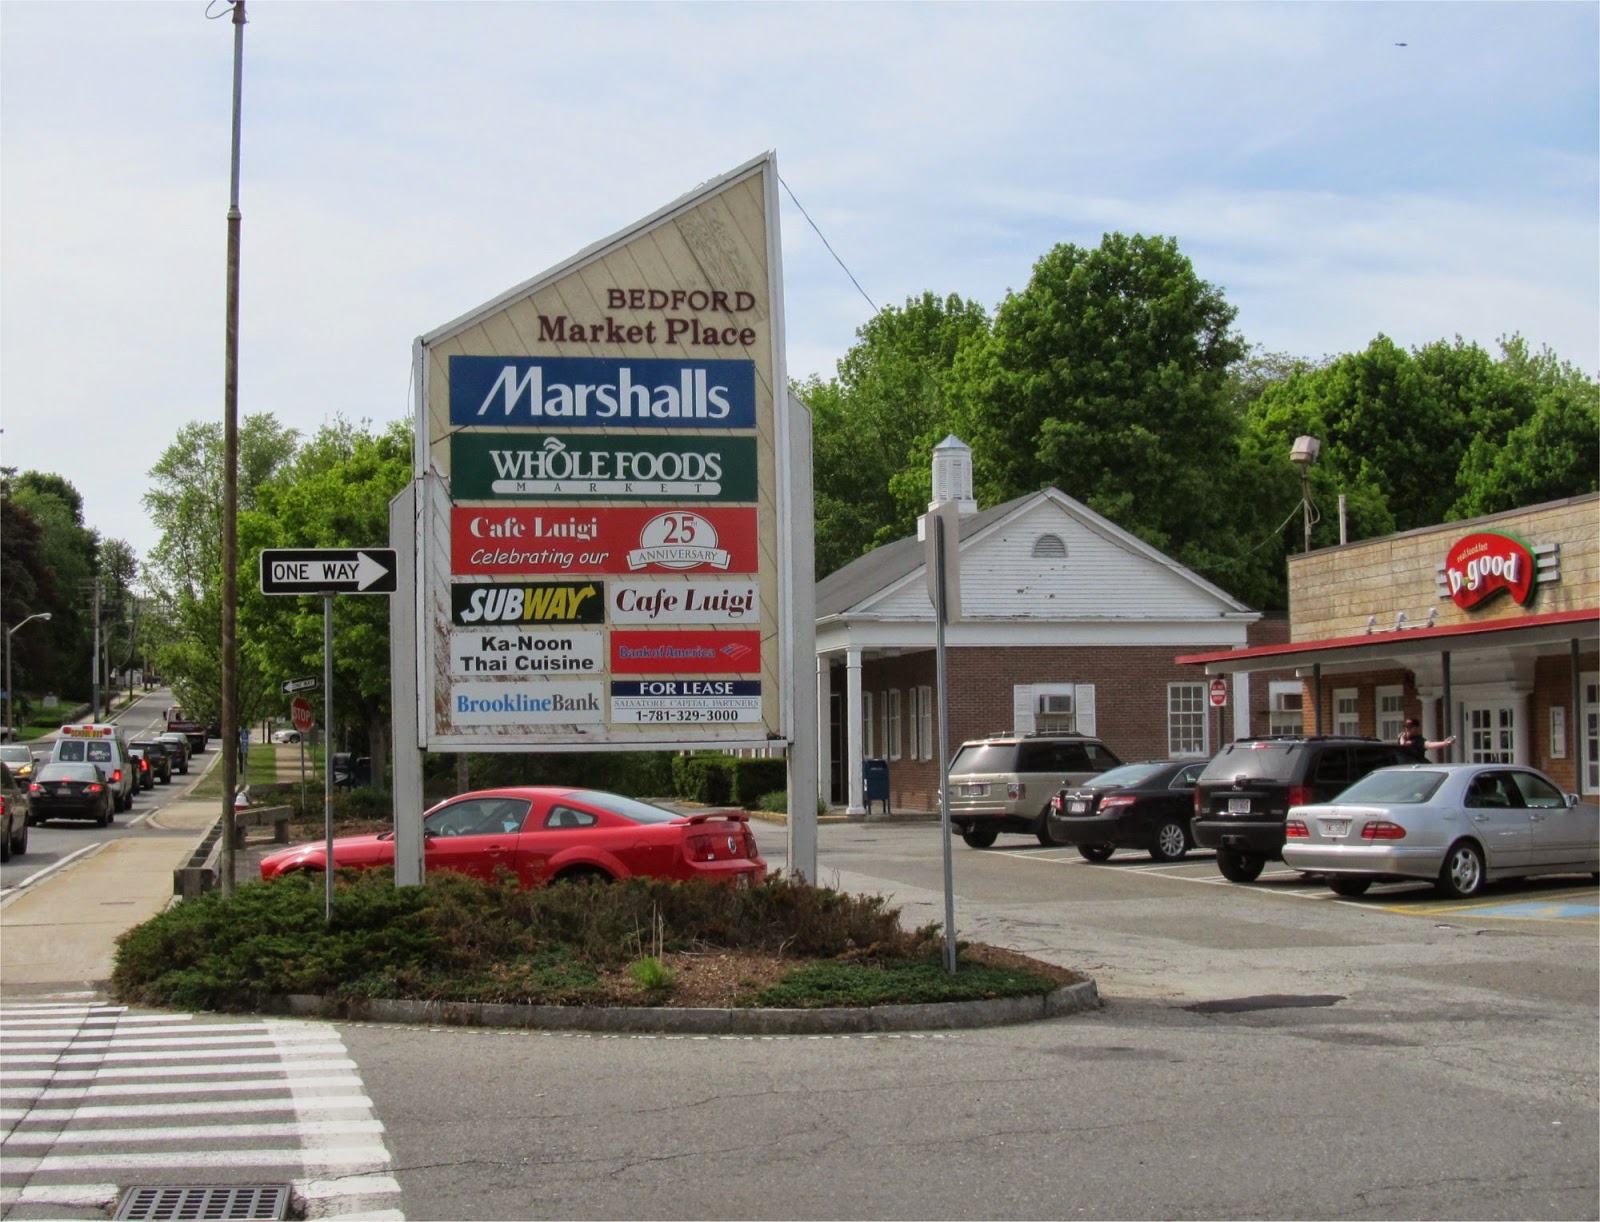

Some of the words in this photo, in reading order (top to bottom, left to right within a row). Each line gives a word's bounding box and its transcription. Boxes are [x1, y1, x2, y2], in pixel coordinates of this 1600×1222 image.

[608, 288, 756, 312] BEDFORD
[538, 316, 656, 344] Market
[665, 318, 756, 345] Place
[477, 366, 730, 418] Marshalls
[489, 449, 611, 480] WHOLE
[614, 452, 722, 481] FOODS
[516, 482, 703, 493] MARKET
[470, 516, 526, 538] Cafe
[534, 516, 598, 542] Luigi
[470, 548, 574, 569] Celebrating
[579, 552, 609, 565] our
[638, 549, 718, 562] ANNIVERSARY
[274, 564, 309, 580] ONE
[323, 563, 359, 580] WAY
[460, 584, 596, 623] SUBWAY
[616, 588, 678, 619] Cafe
[685, 588, 754, 619] Luigi
[481, 636, 572, 651] Ka-Noon
[619, 645, 650, 659] Bank
[652, 646, 664, 658] of
[665, 646, 716, 659] America
[460, 656, 507, 671] Thai
[515, 655, 594, 671] Cuisine
[639, 682, 676, 695] FOR
[683, 682, 734, 695] LEASE
[457, 692, 601, 713] BrooklineBank
[614, 700, 666, 708] SALVATORE
[670, 700, 709, 708] CAPITAL
[712, 700, 759, 708] PARTNERS
[293, 707, 310, 722] STOP
[636, 710, 738, 722] 1-781-329-3000
